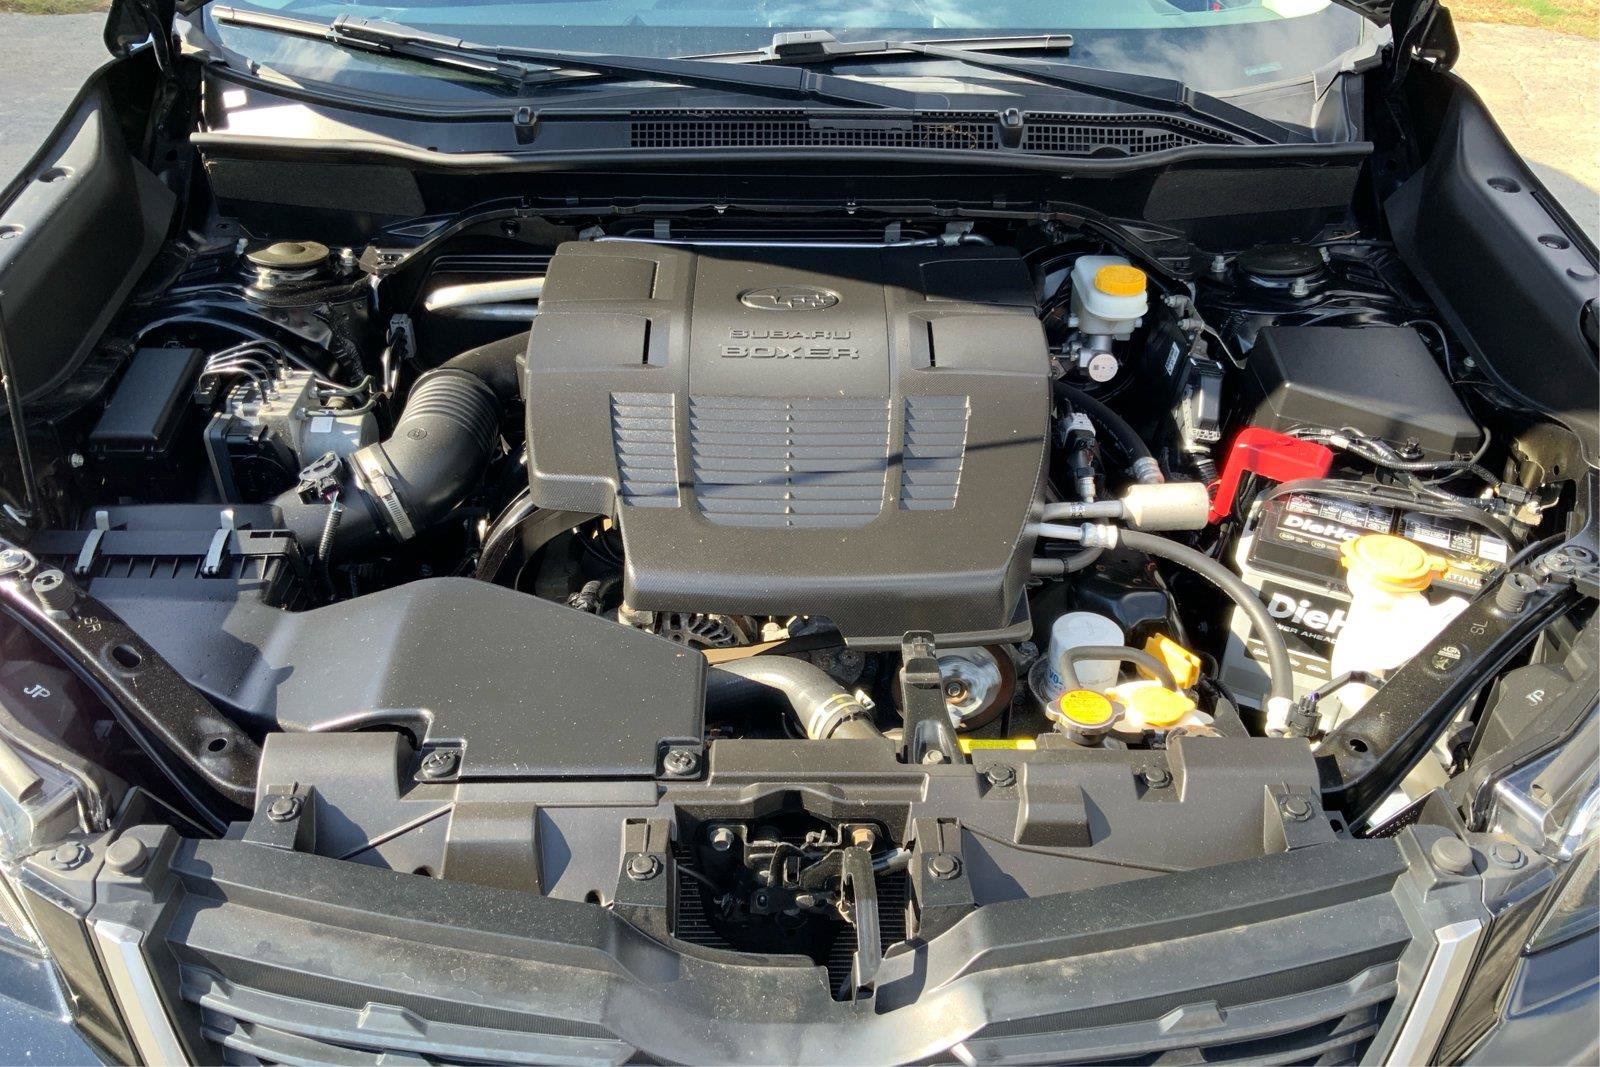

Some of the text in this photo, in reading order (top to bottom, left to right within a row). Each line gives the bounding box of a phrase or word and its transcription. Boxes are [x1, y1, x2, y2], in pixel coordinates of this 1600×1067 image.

[729, 329, 852, 340] SUBARU
[721, 345, 860, 360] BOXER
[1471, 620, 1488, 635] SL
[23, 684, 51, 698] JP
[1526, 689, 1545, 706] JP
